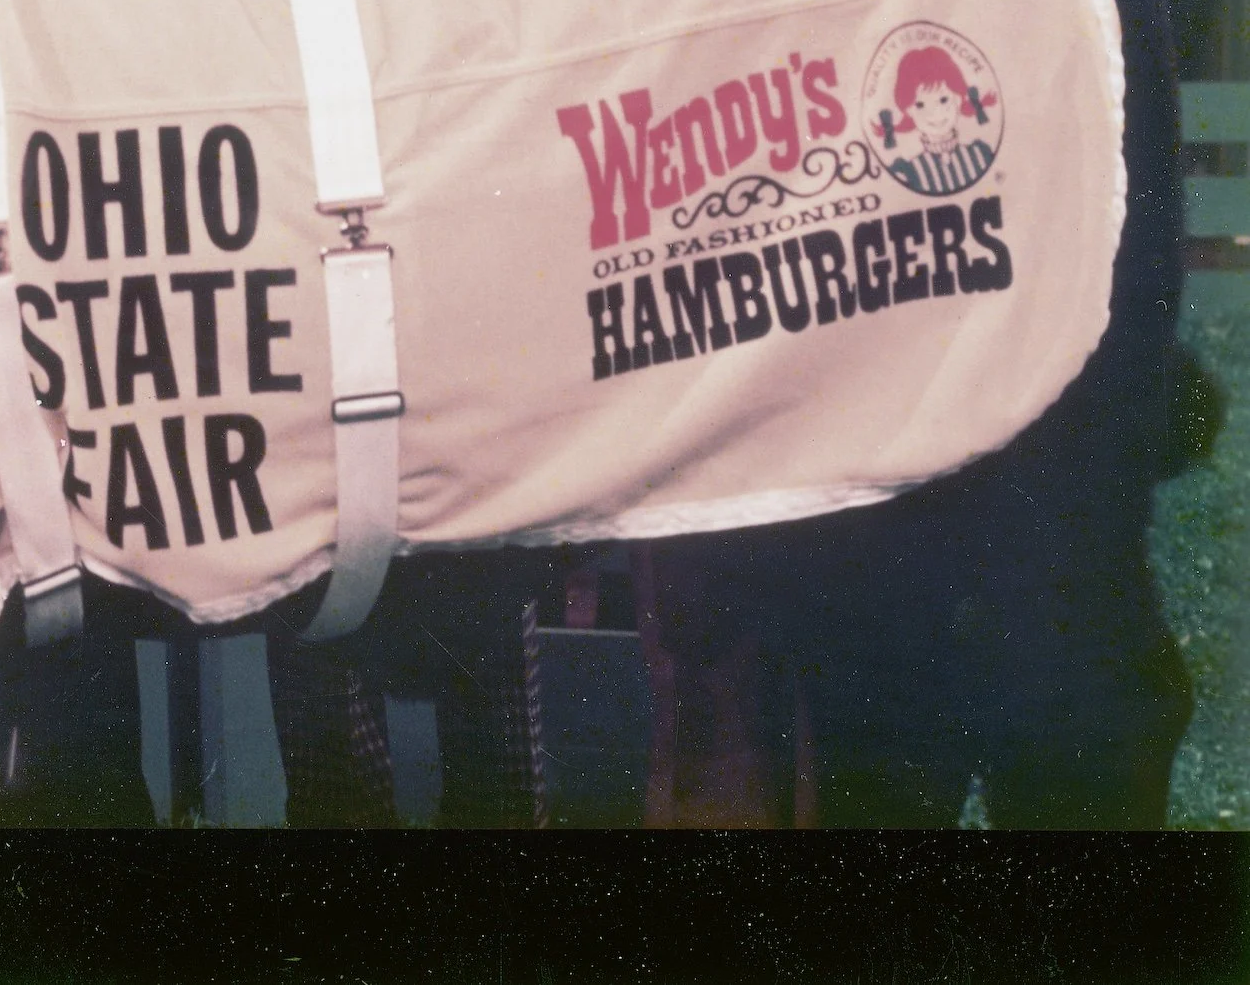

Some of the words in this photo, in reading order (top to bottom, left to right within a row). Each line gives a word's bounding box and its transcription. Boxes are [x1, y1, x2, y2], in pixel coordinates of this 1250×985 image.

[21, 124, 260, 262] OHIO
[592, 247, 655, 279] OLD
[662, 192, 882, 261] FASHIONED
[15, 268, 303, 411] STATE
[586, 195, 1014, 382] HAMBURGERS
